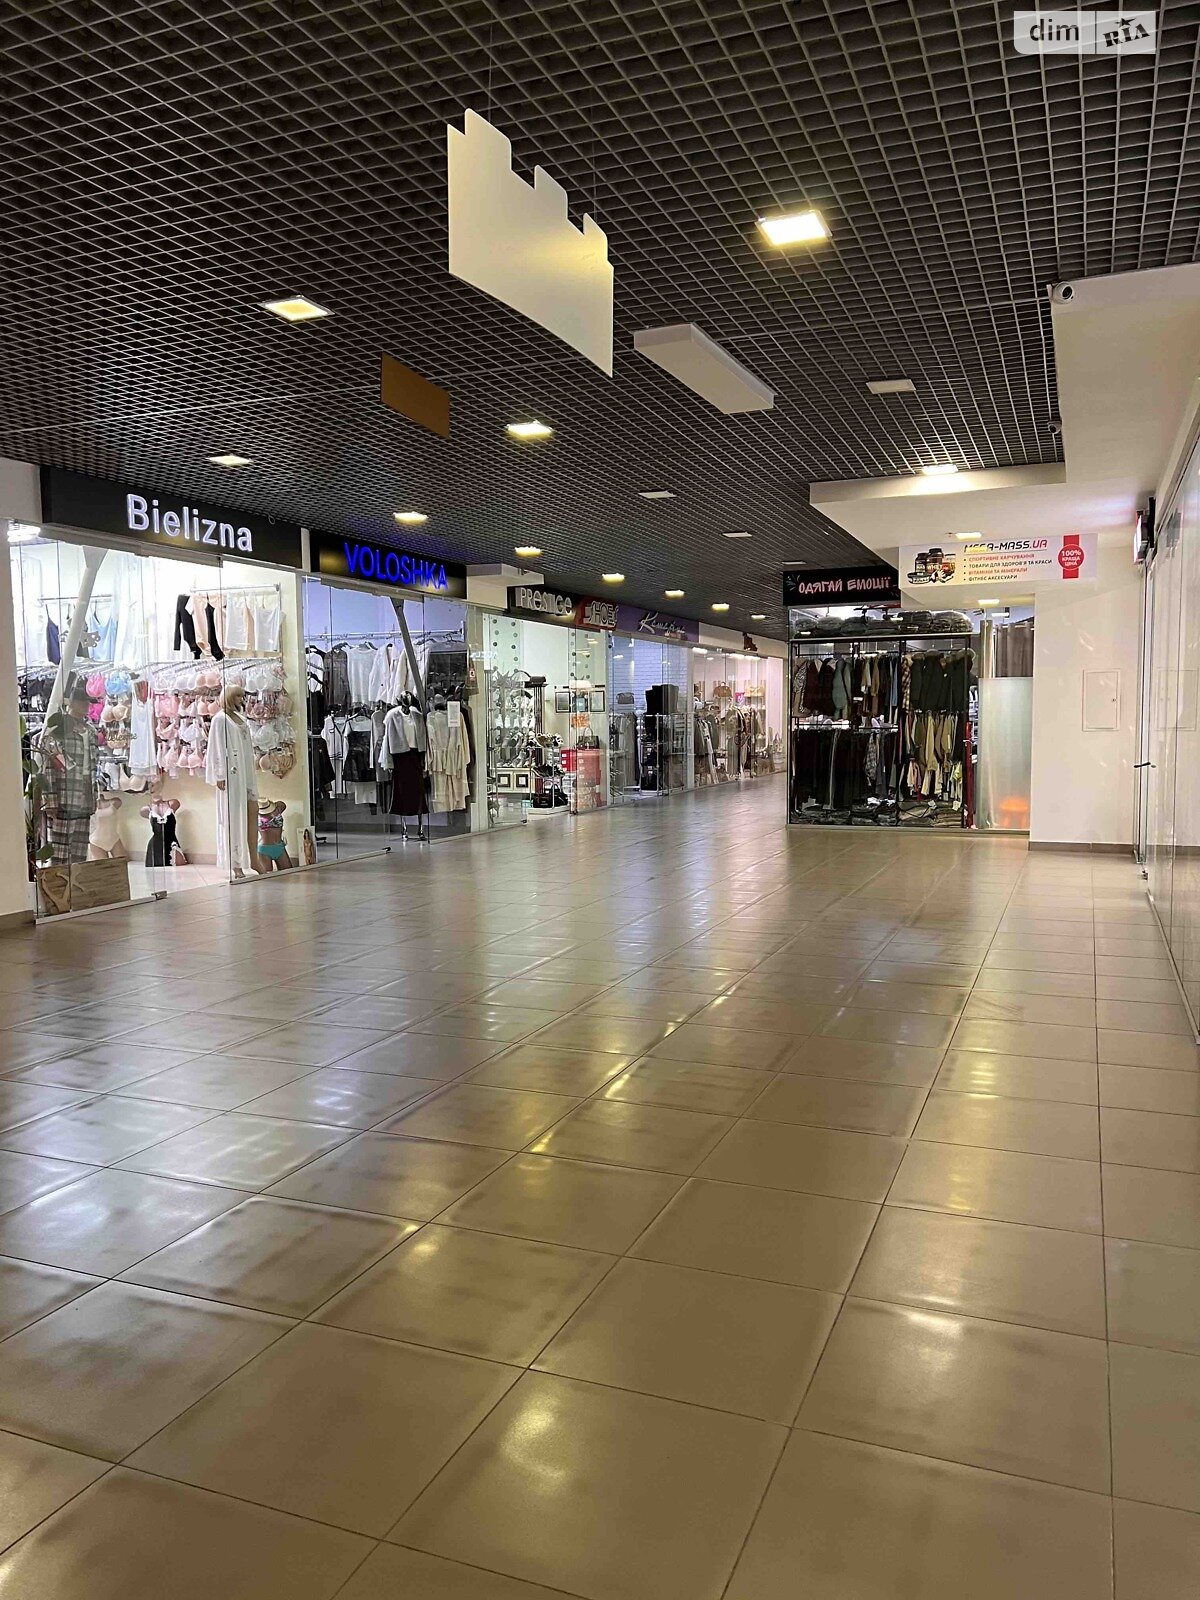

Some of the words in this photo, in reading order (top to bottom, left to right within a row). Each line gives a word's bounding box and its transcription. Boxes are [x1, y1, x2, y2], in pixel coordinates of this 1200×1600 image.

[126, 493, 253, 552] Bielizna
[344, 542, 449, 590] VOLOSHKA
[798, 579, 843, 595] ОДЯГАЙ
[847, 576, 891, 591] ЕМОЦІЇ
